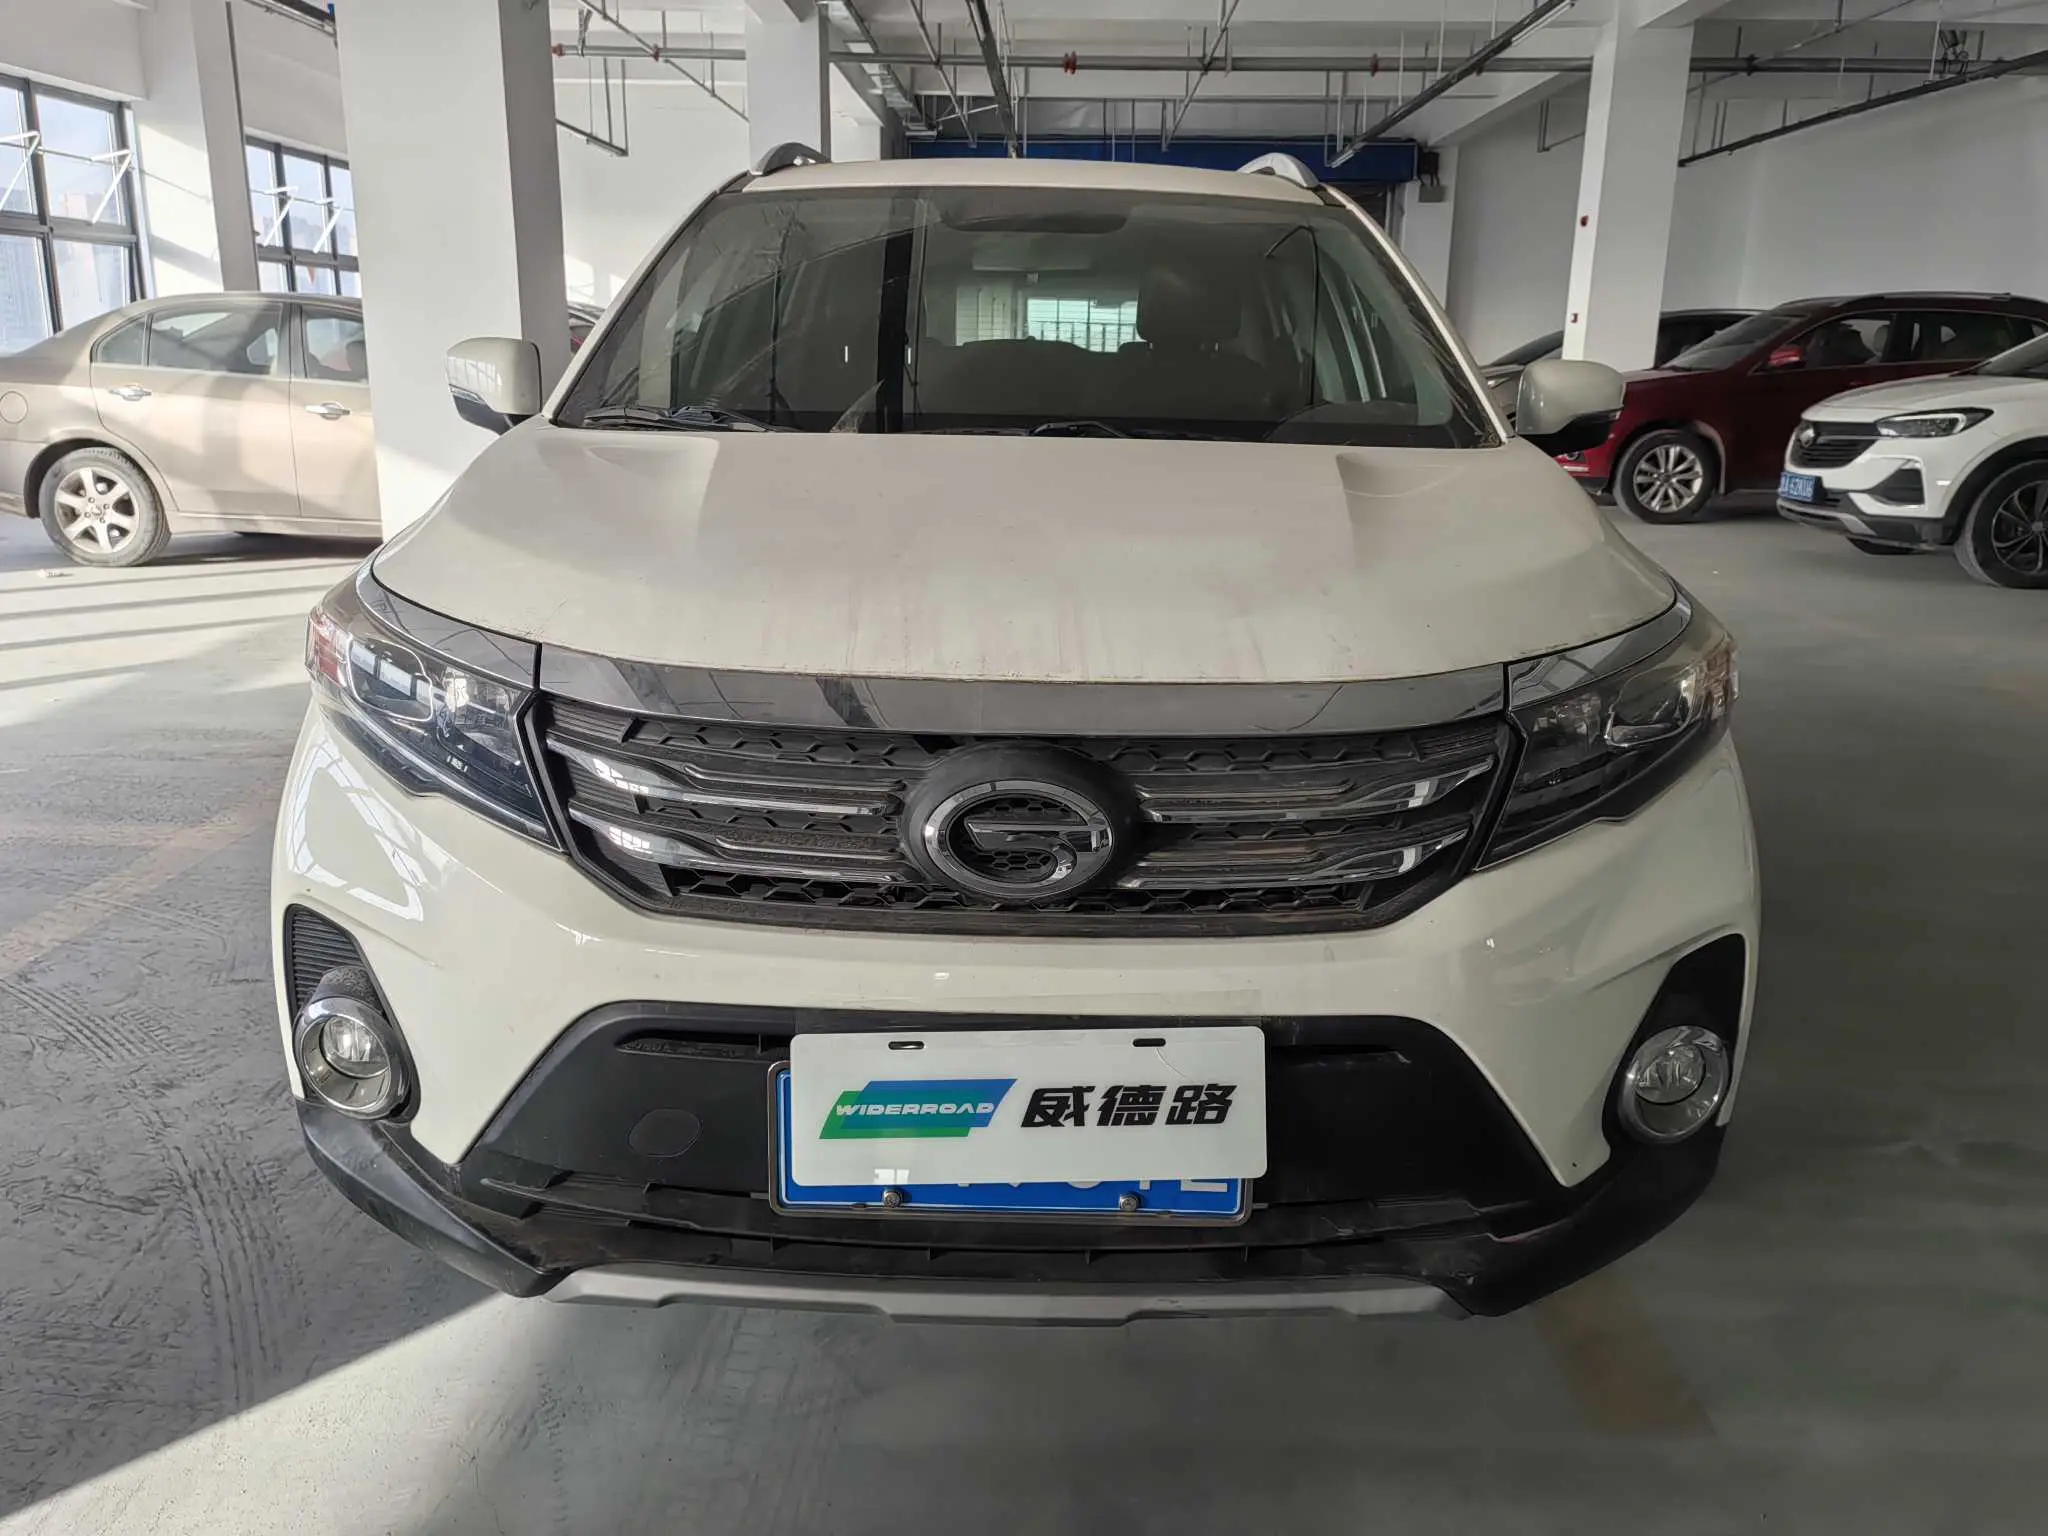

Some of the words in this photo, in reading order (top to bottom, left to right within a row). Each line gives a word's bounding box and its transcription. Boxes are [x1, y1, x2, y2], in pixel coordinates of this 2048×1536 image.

[836, 1103, 995, 1116] WIDERROAD
[1021, 1084, 1237, 1127] 威德路
